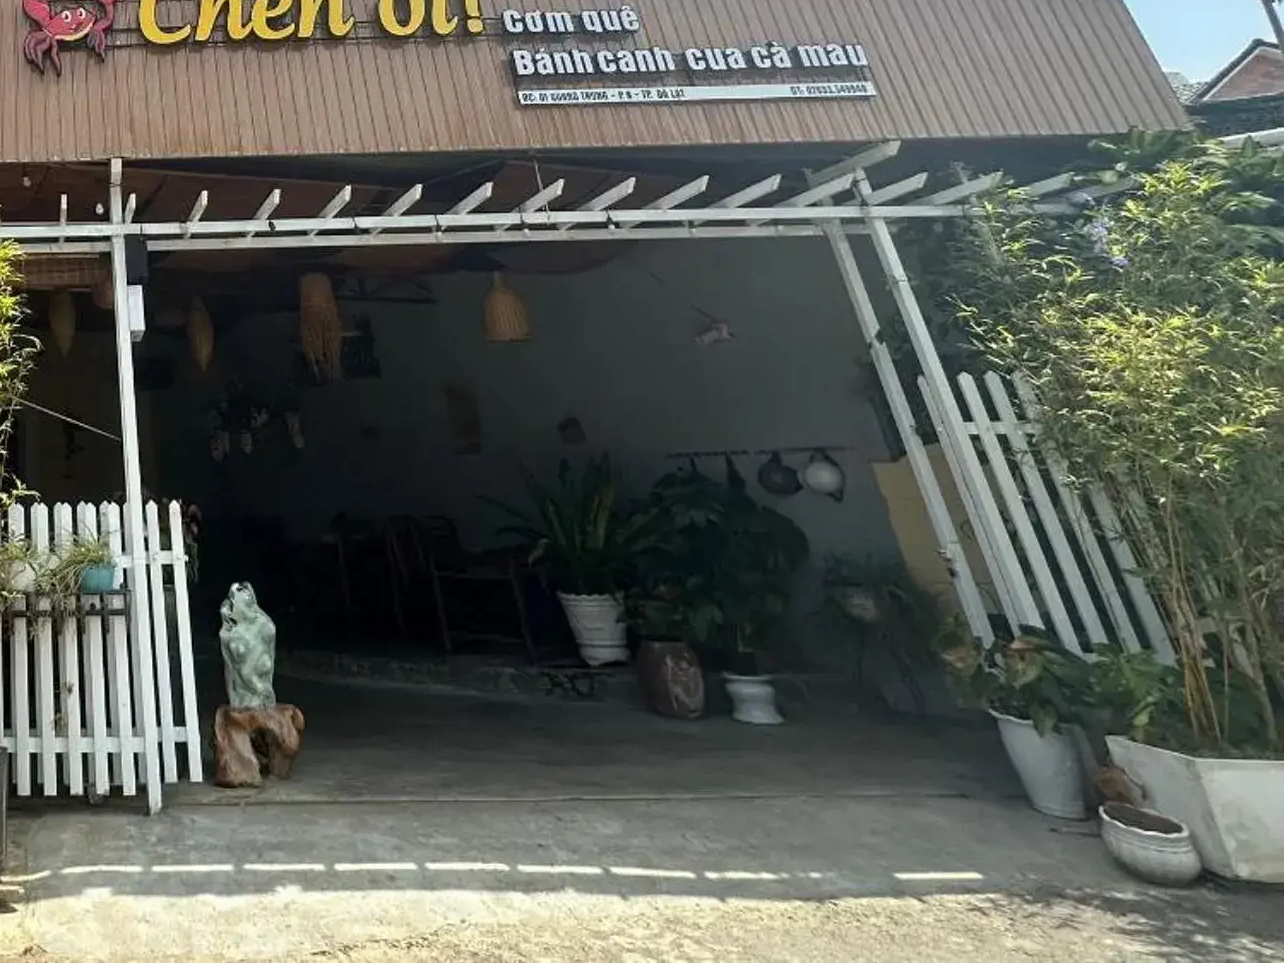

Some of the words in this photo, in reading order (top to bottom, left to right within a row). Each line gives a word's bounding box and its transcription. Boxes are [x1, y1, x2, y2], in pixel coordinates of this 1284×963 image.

[502, 8, 575, 33] Cơm
[582, 5, 640, 33] quê
[513, 47, 594, 76] Bánh
[684, 47, 747, 71] cua
[750, 41, 792, 69] cà
[797, 43, 868, 67] mau
